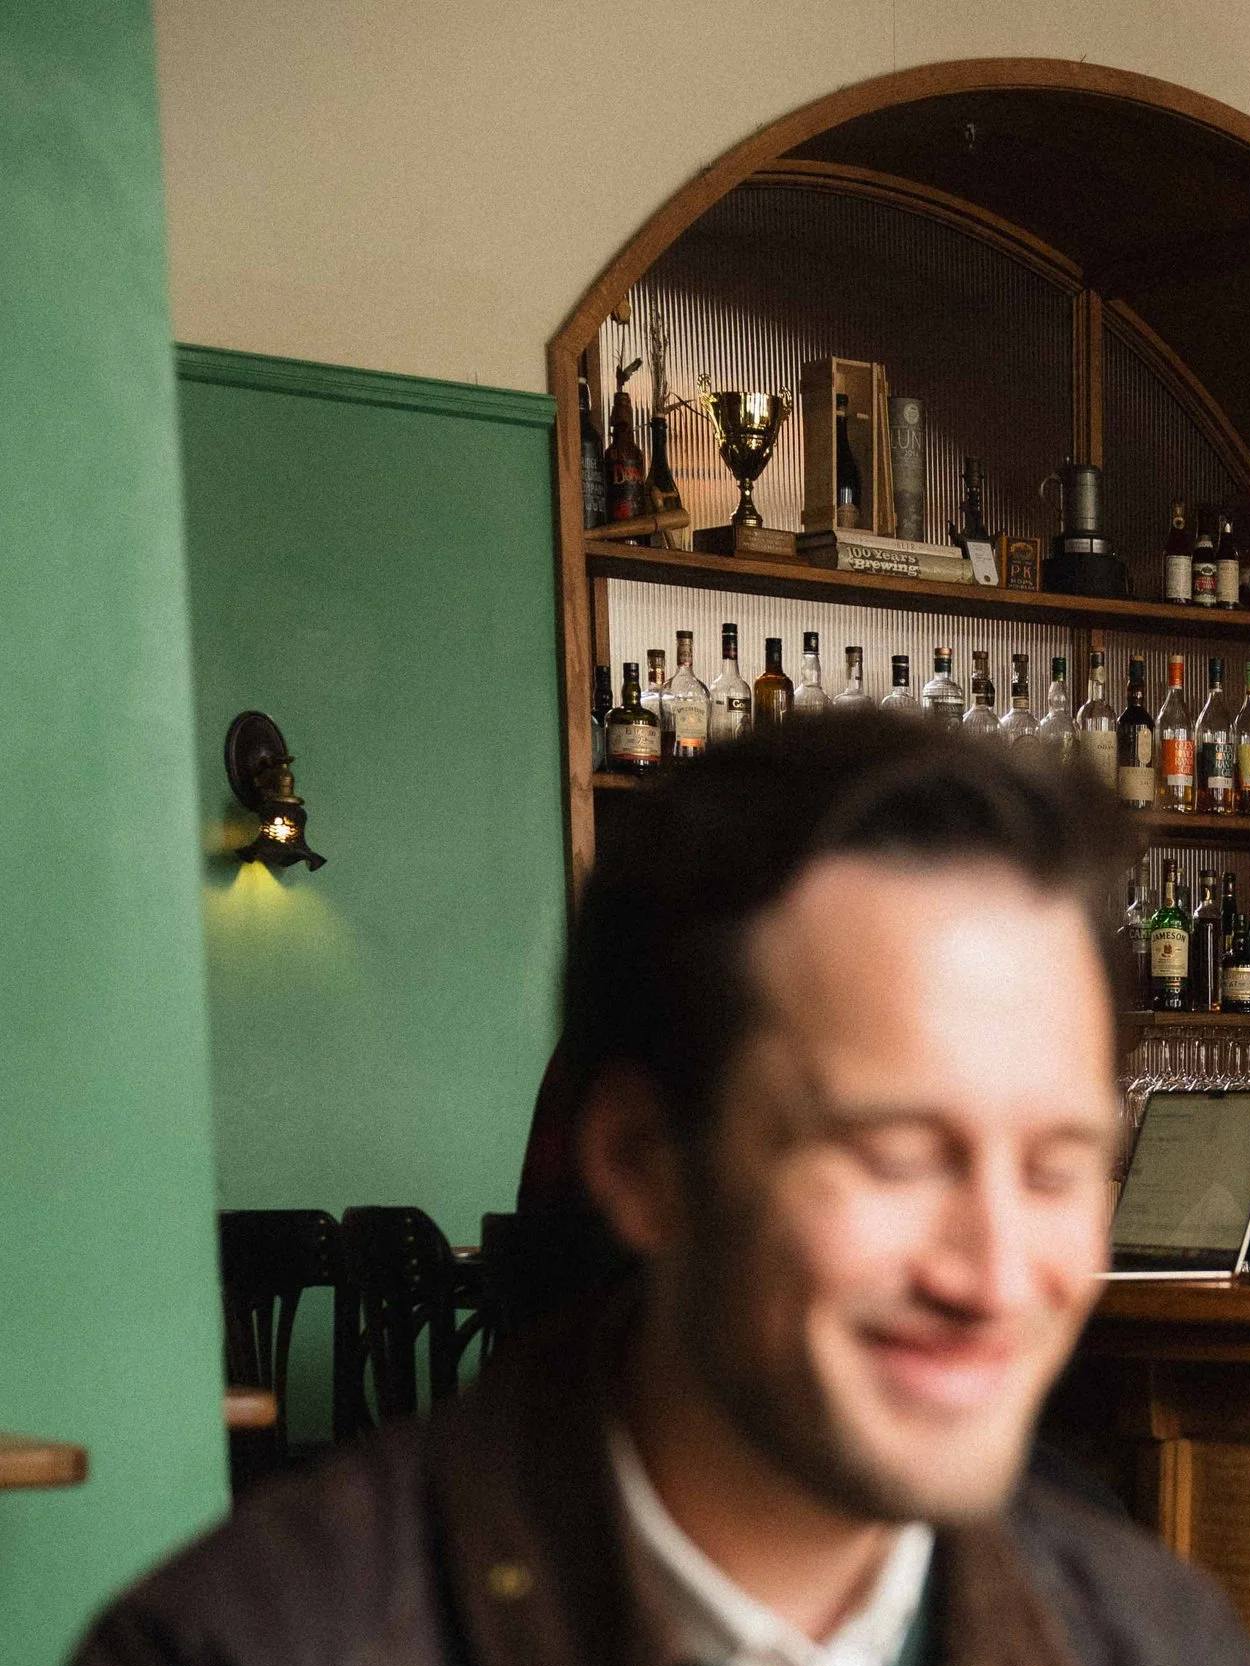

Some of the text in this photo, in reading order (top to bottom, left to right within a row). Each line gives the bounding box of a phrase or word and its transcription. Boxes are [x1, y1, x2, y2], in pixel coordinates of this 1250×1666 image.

[846, 546, 916, 563] 100 Years
[853, 557, 919, 576] Brewing
[1174, 740, 1193, 750] GLEN
[1215, 744, 1233, 753] GLEN
[1152, 931, 1186, 943] JAMESON
